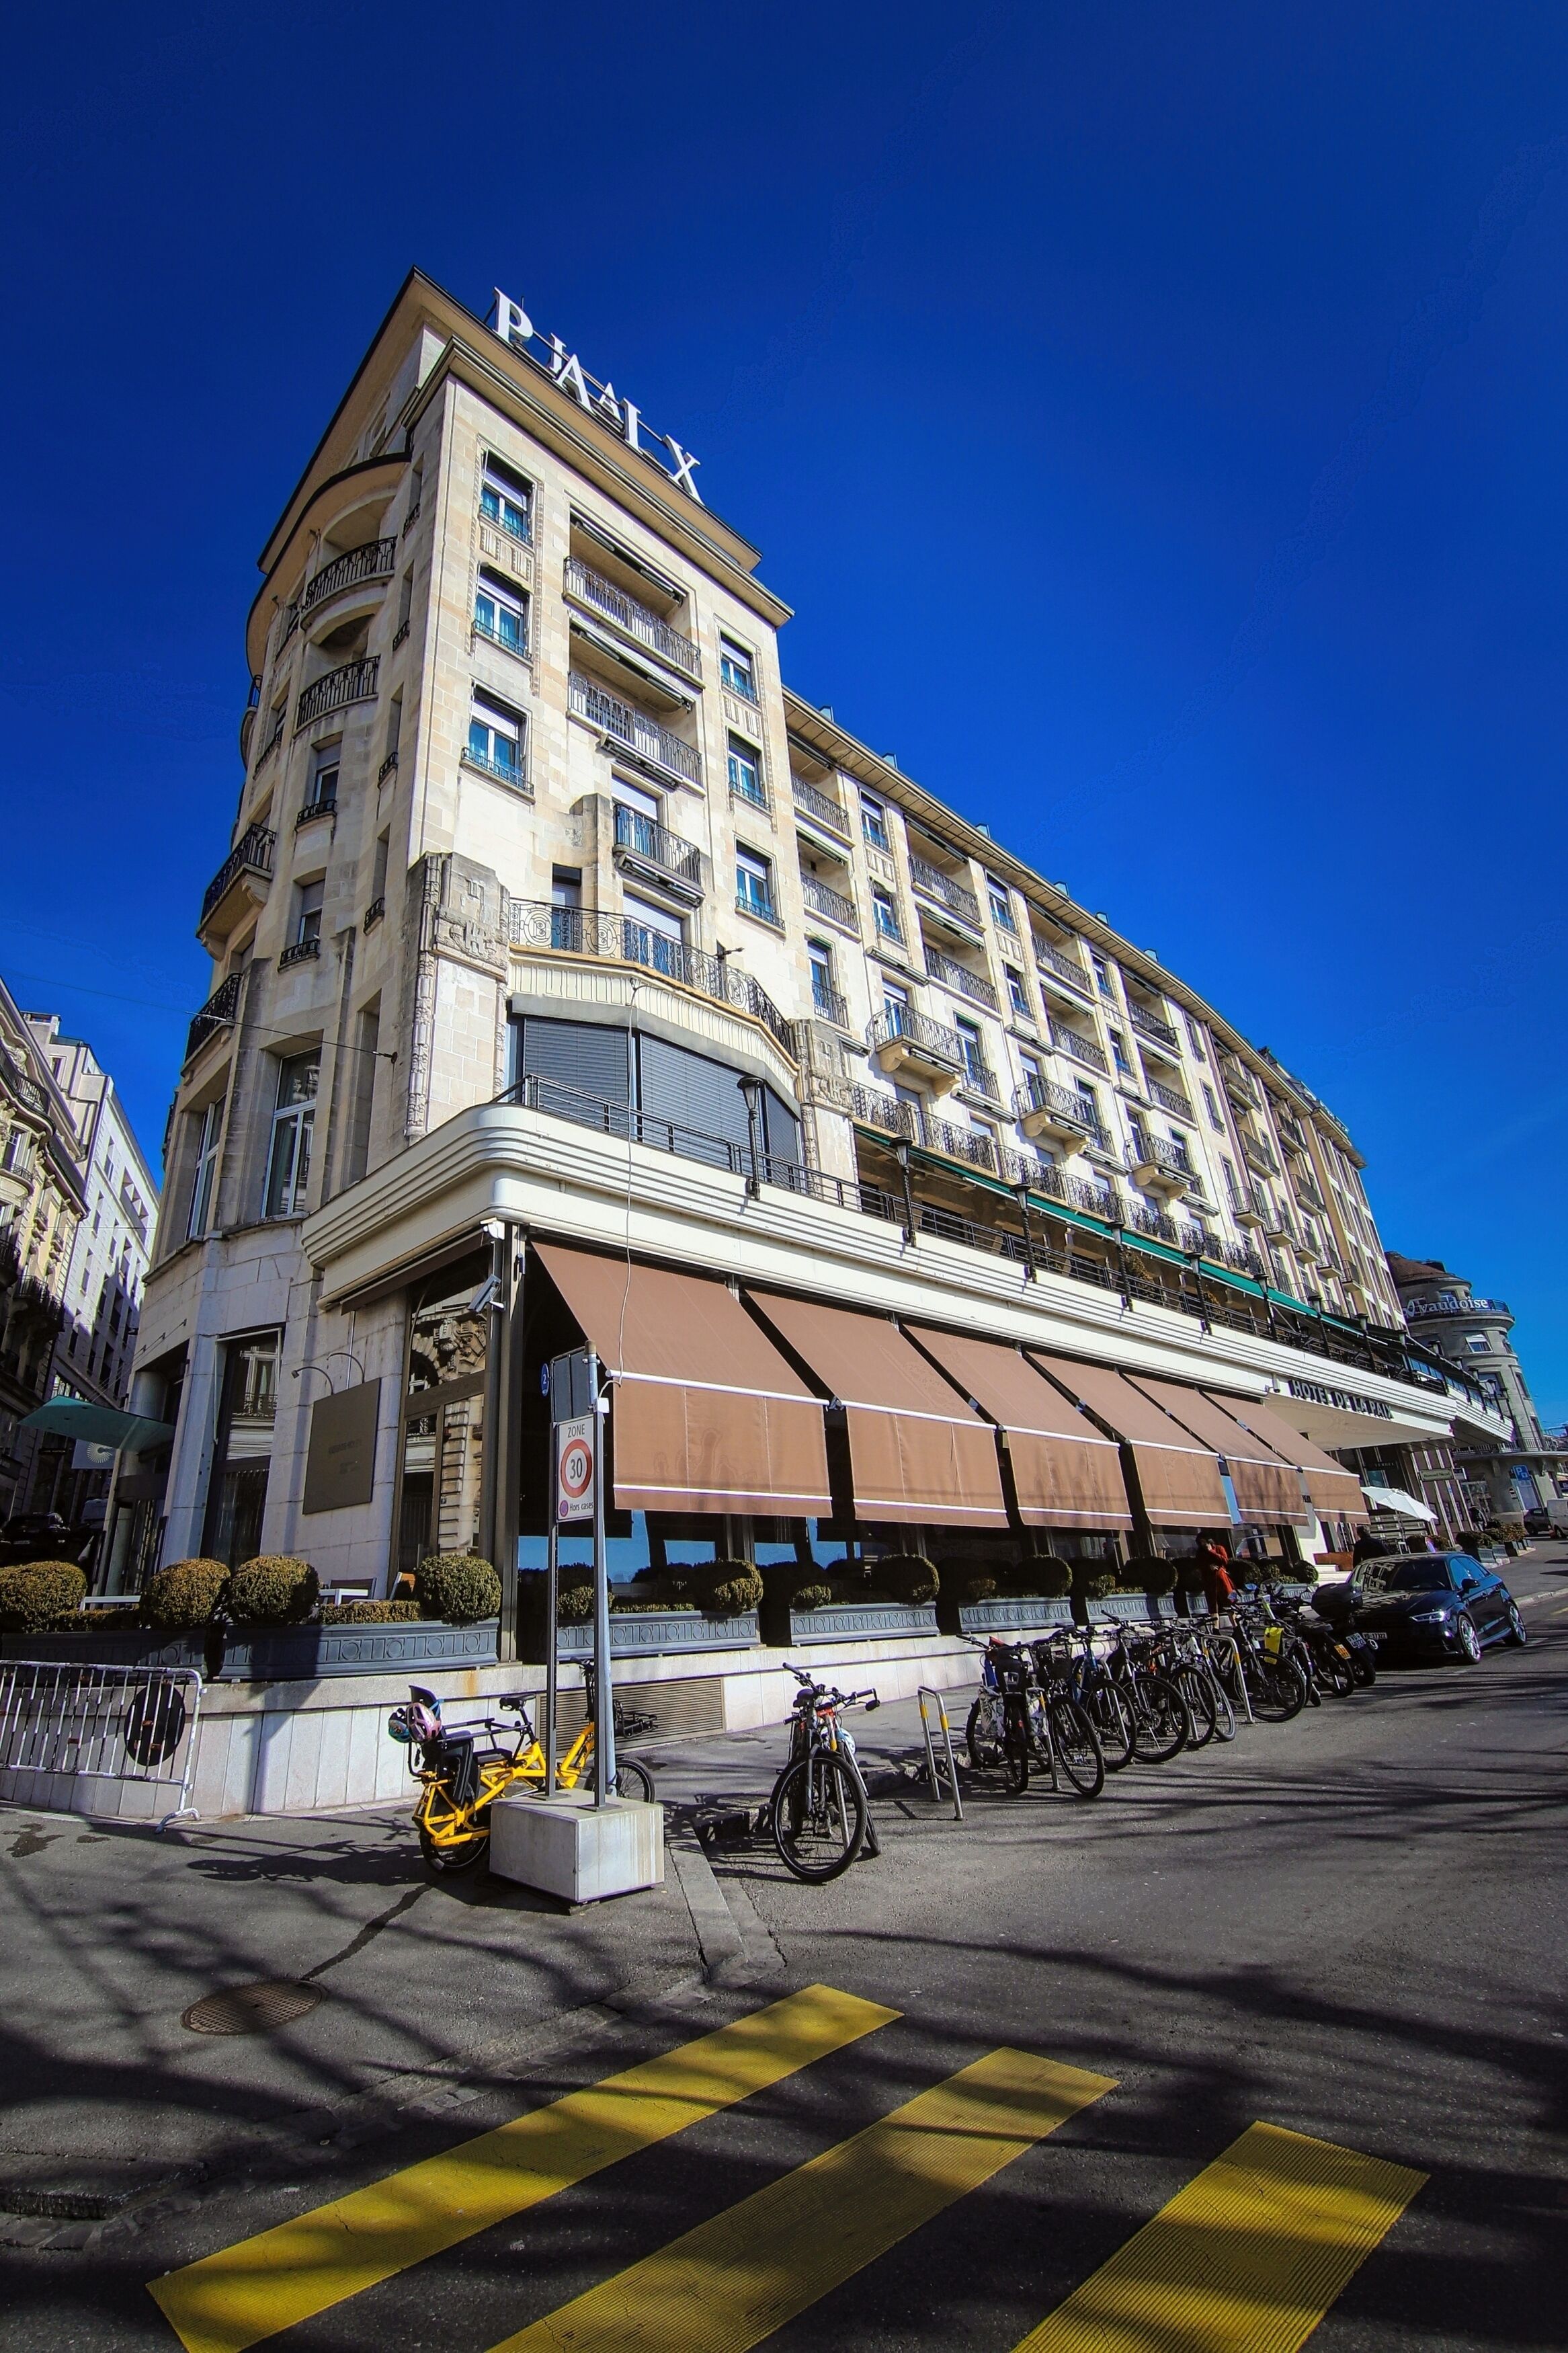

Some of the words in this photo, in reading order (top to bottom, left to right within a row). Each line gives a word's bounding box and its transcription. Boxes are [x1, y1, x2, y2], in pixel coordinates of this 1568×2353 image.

[1419, 1296, 1488, 1314] vaudoise
[542, 1373, 547, 1384] 2
[1289, 1380, 1331, 1405] HOTEL
[1333, 1390, 1350, 1410] DE
[1350, 1396, 1366, 1413] LA
[1368, 1400, 1394, 1419] PAIX
[567, 1423, 585, 1438] ZONE
[570, 1457, 583, 1479] 30
[1516, 1467, 1522, 1475] P
[569, 1503, 580, 1511] Hors
[581, 1501, 593, 1510] cases
